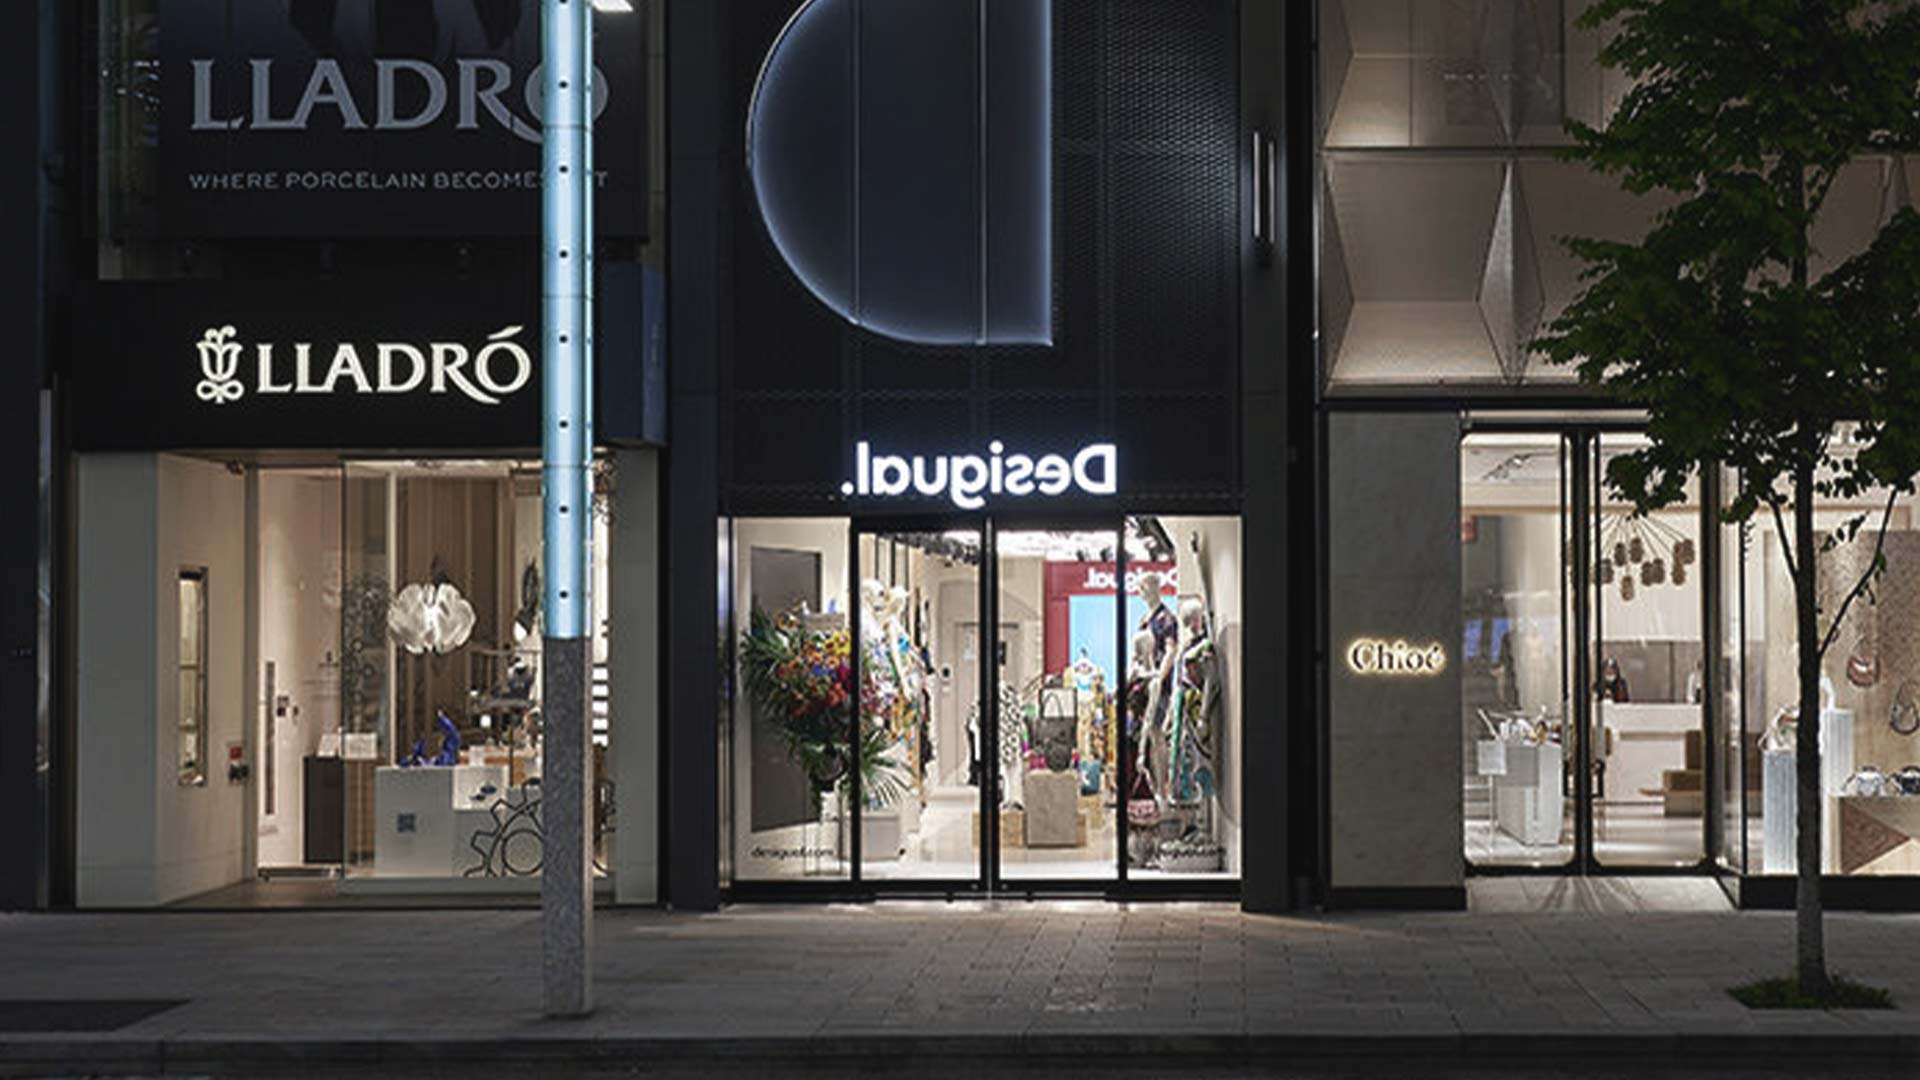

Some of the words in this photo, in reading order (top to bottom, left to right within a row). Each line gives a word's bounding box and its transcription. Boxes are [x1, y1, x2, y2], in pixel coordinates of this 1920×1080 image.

[189, 171, 278, 189] WHERE
[285, 171, 426, 189] PORCELAIN
[434, 171, 544, 189] BECOME
[257, 325, 531, 404] LLADRÓ
